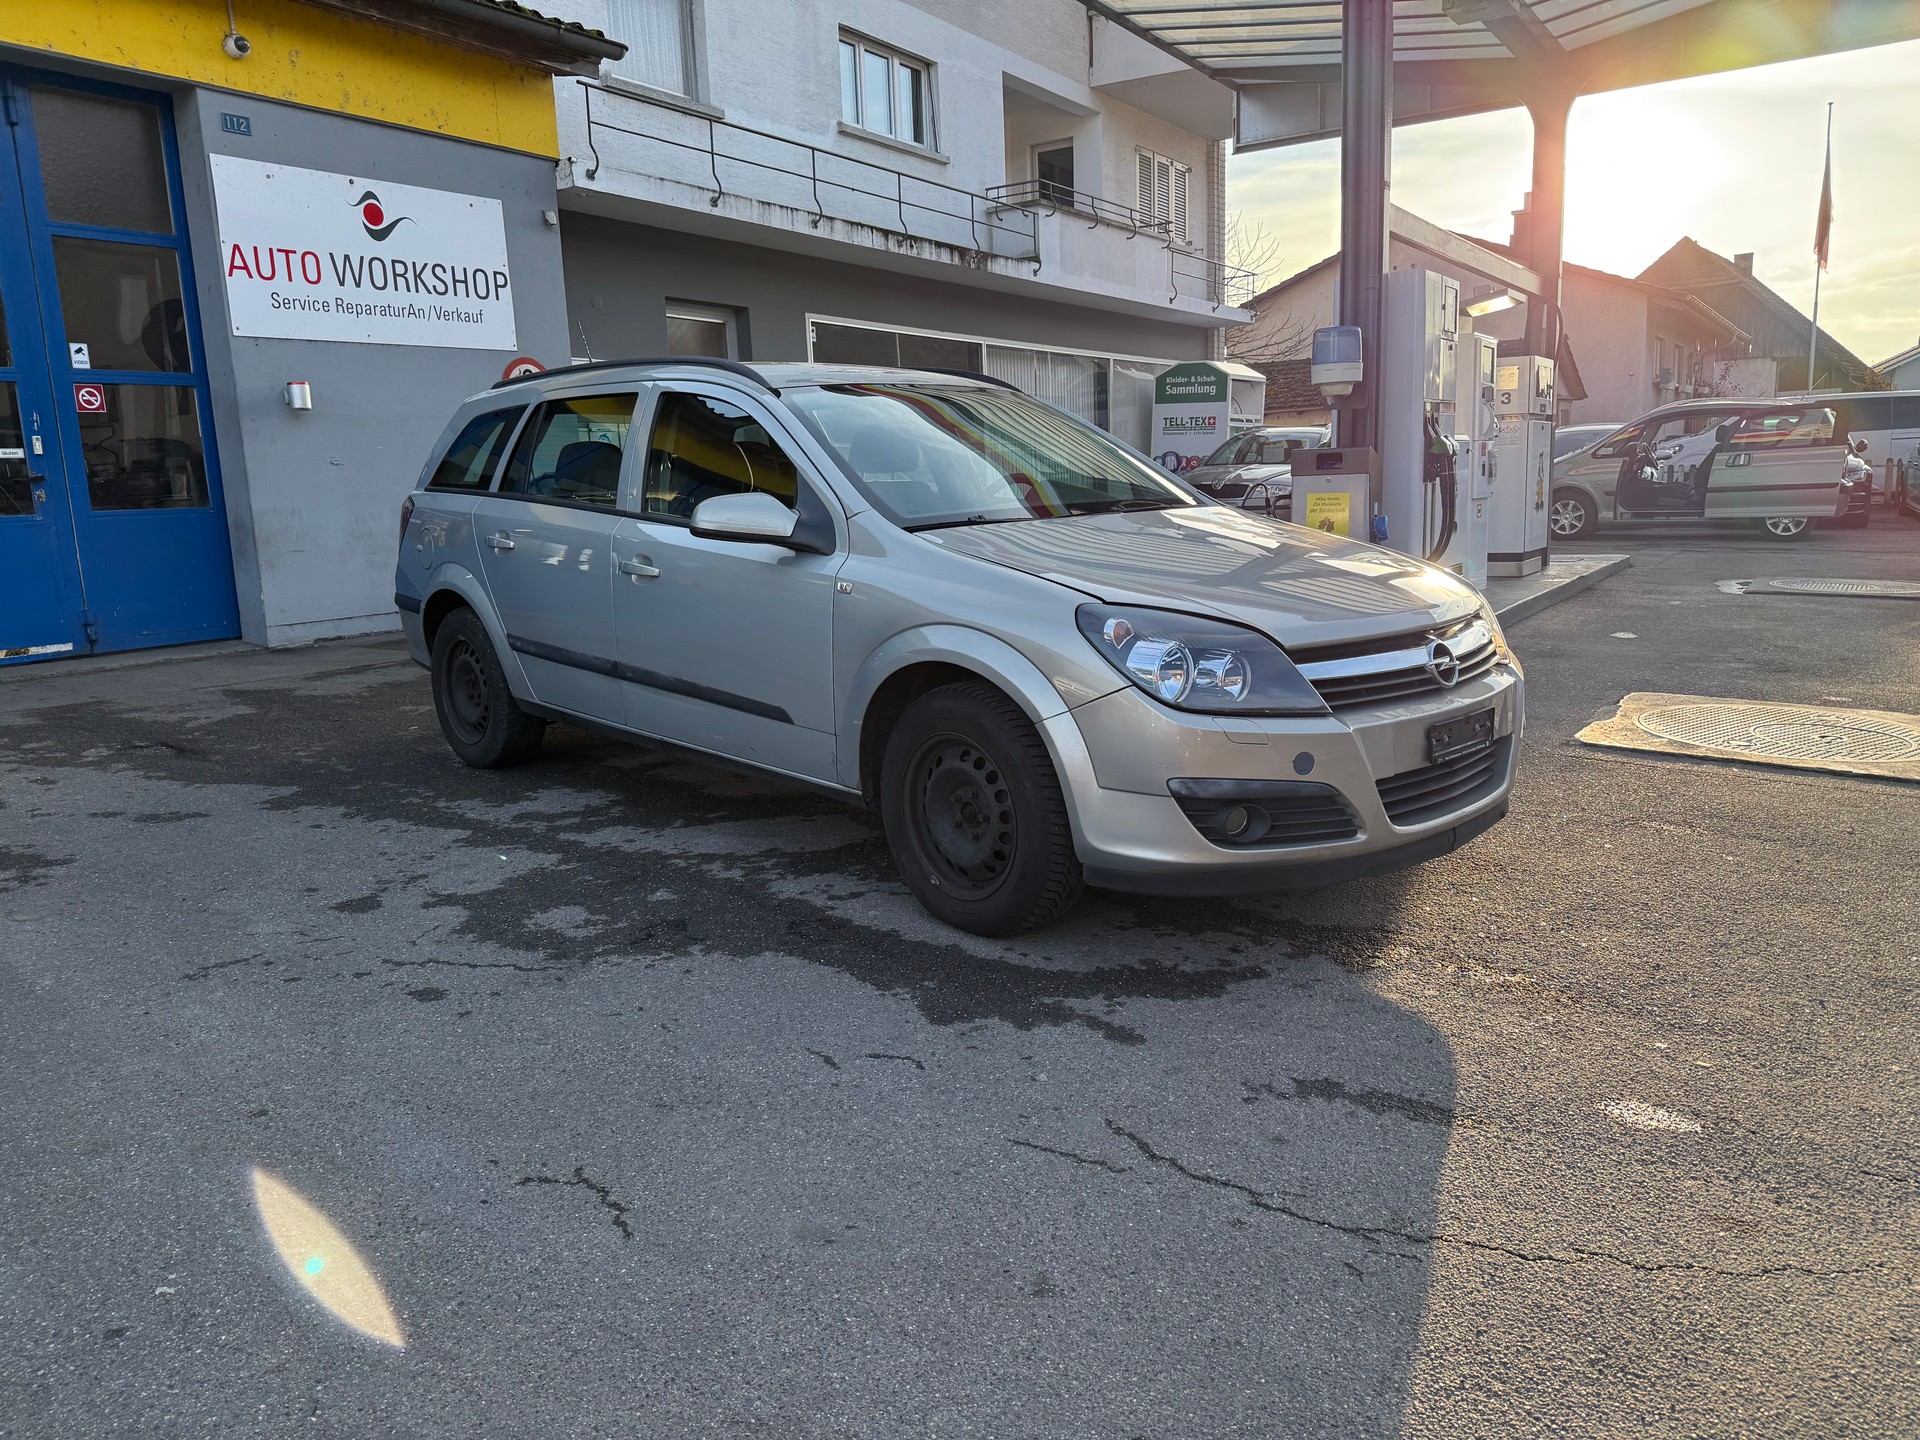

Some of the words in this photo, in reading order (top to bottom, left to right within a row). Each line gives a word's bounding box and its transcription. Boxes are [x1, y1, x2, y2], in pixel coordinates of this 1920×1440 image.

[225, 116, 247, 131] 112
[228, 243, 322, 285] AUTO
[328, 252, 508, 301] WORKSHOP
[271, 292, 331, 313] Service
[335, 296, 484, 324] ReparaturAn/Verkauf
[1165, 383, 1217, 395] Sammlung
[1501, 392, 1511, 404] 3
[1163, 416, 1207, 427] TELL-TEX
